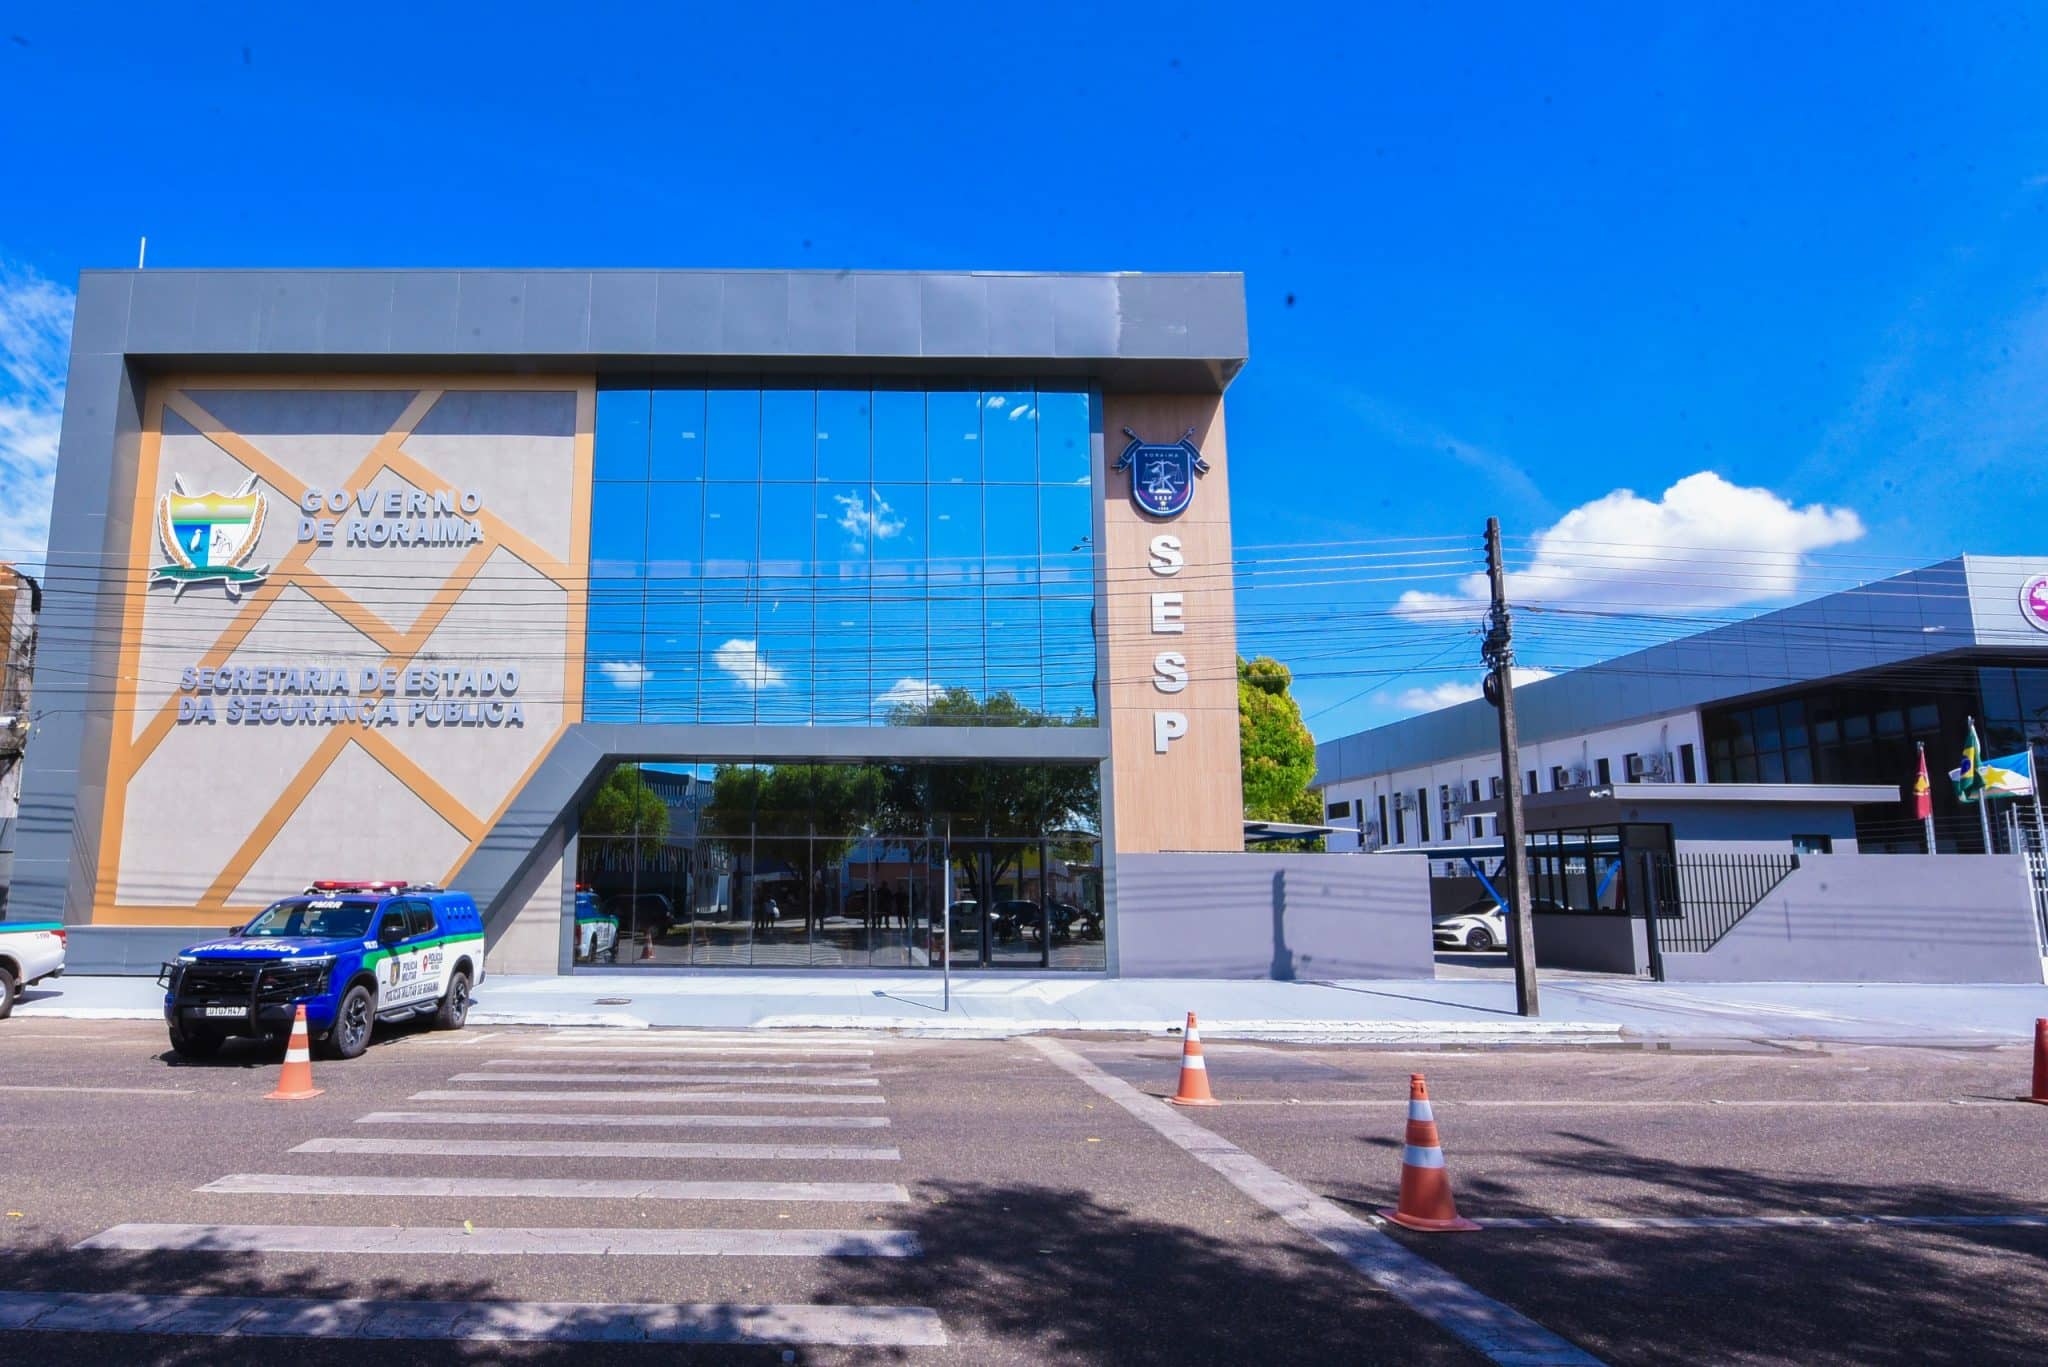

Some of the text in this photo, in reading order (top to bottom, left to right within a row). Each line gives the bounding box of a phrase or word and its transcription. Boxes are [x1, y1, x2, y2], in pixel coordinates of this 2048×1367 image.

[302, 487, 482, 515] GOVERNO
[297, 516, 484, 546] DE RORAIMA
[1149, 534, 1189, 754] SESP
[179, 666, 520, 694] SECRETARIA DE ESTADO
[177, 695, 525, 727] DA SEGURANÇA PÚBLICA
